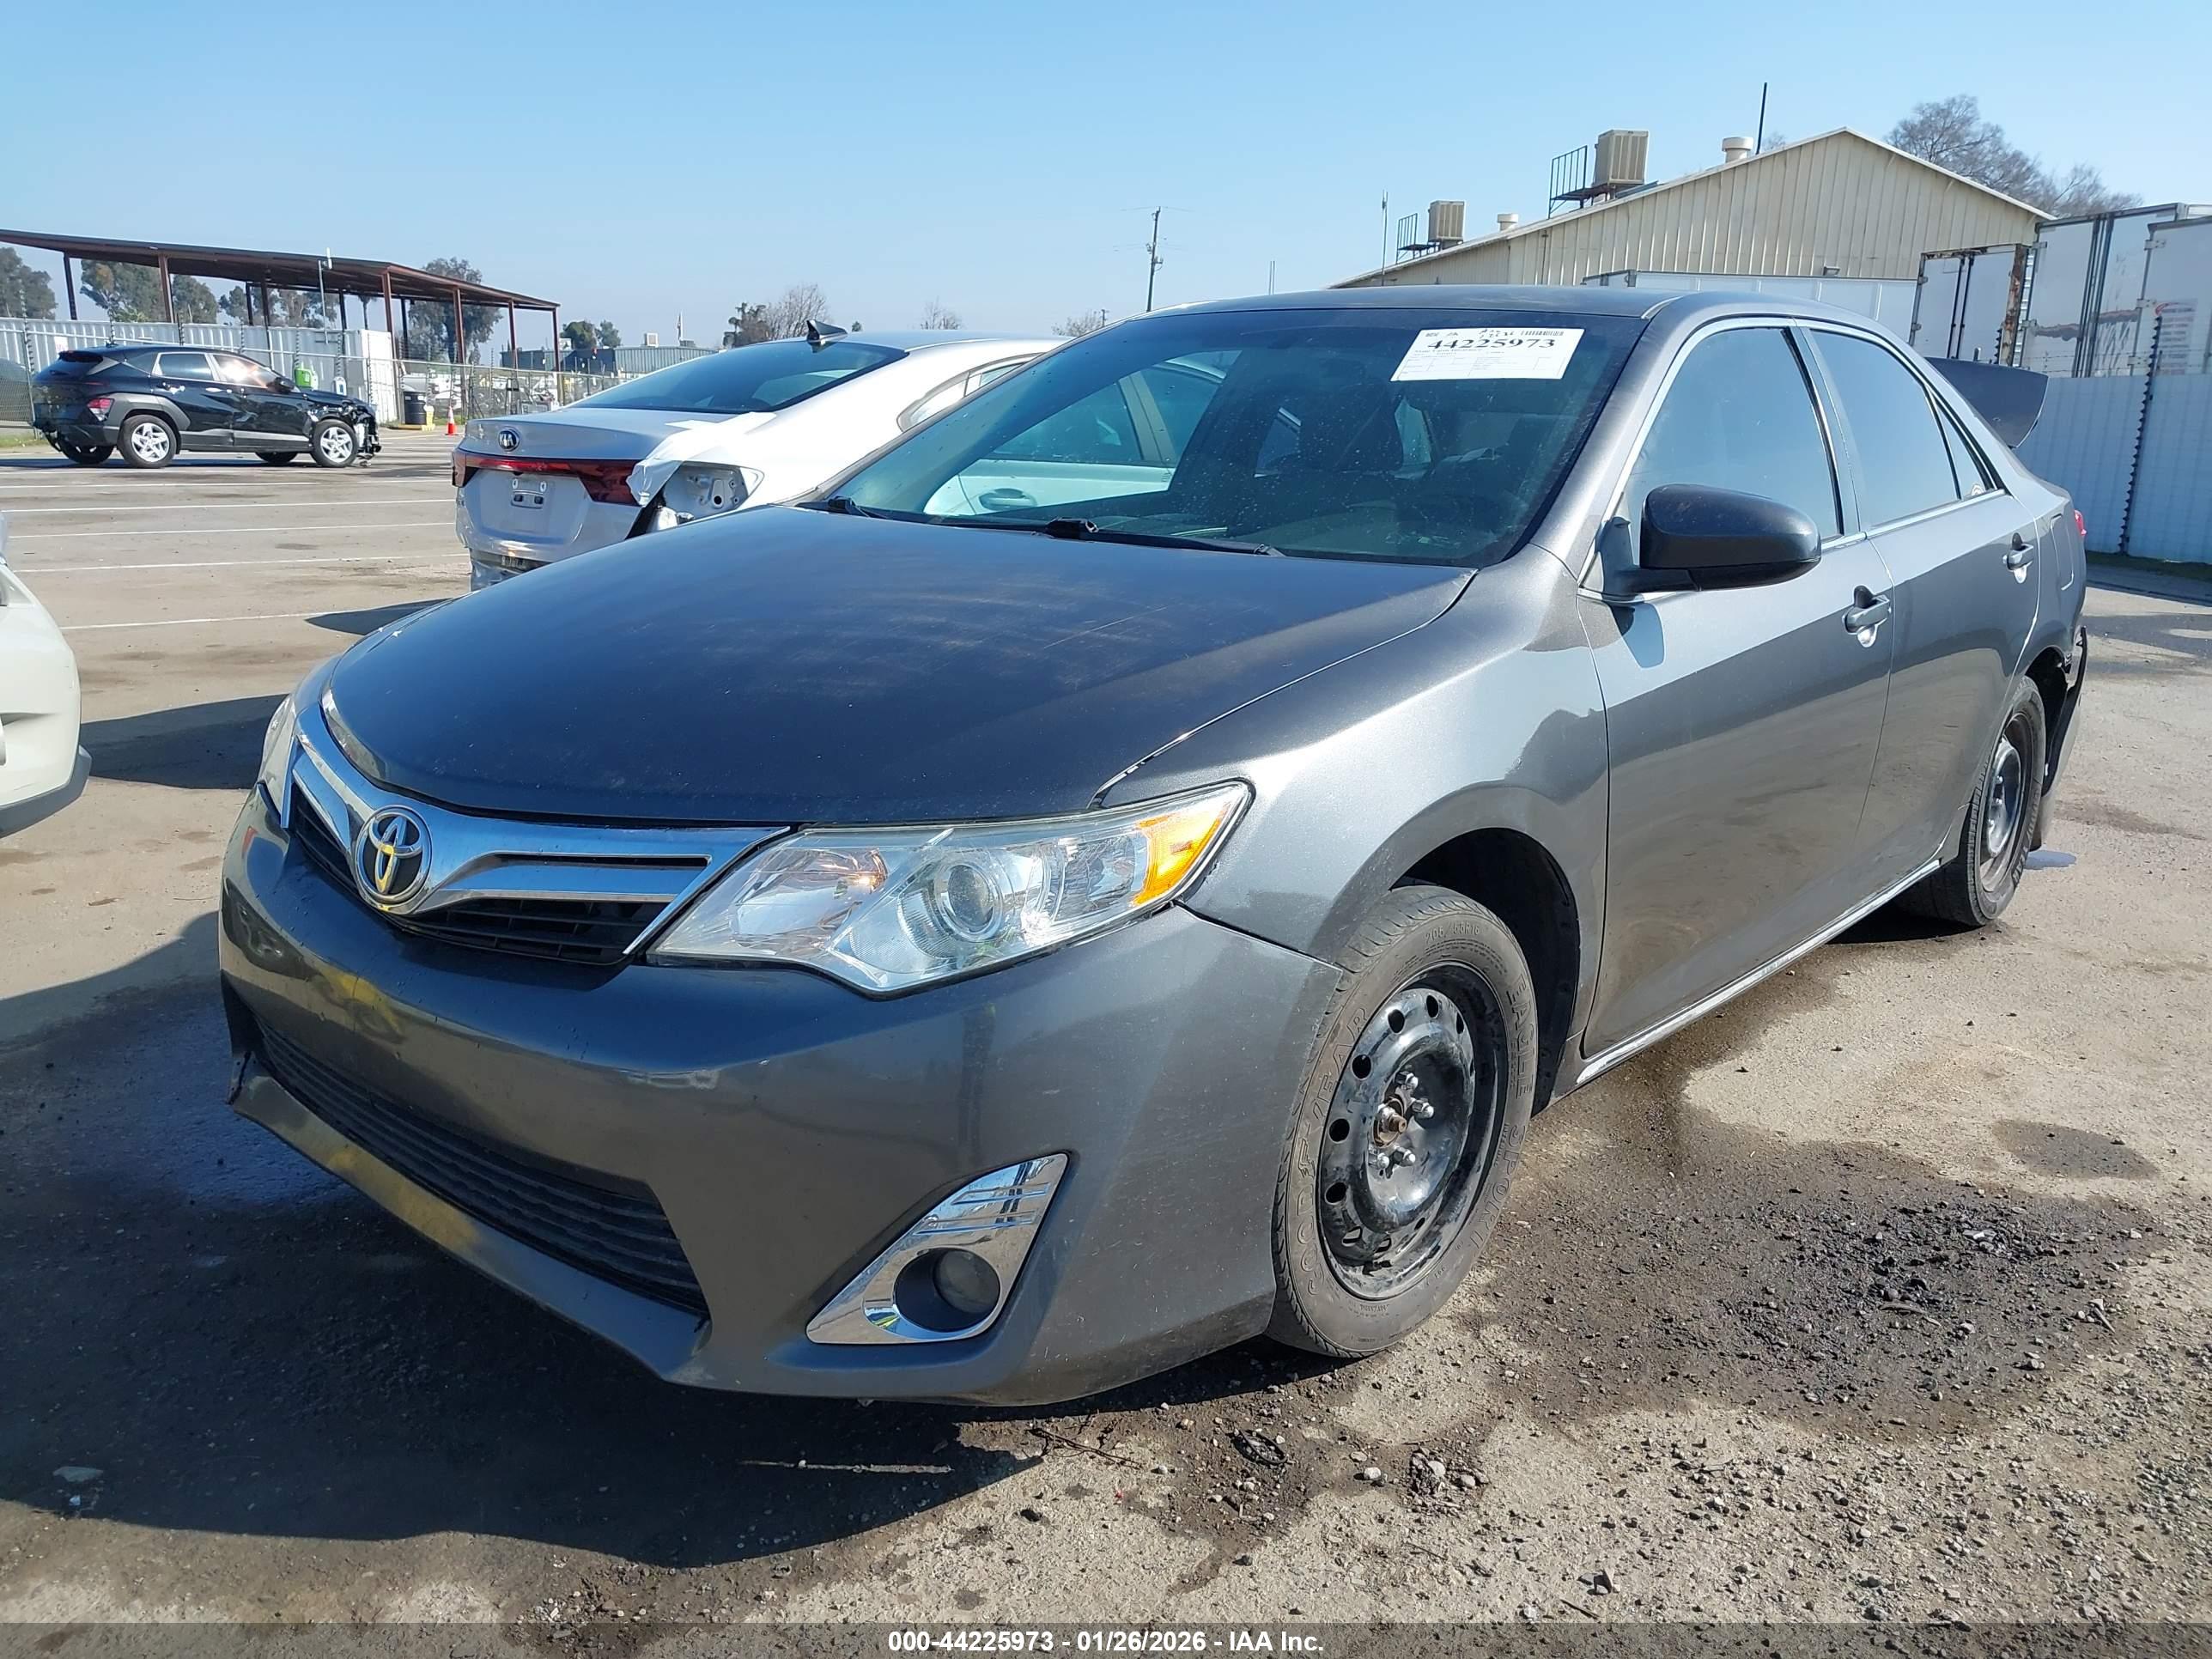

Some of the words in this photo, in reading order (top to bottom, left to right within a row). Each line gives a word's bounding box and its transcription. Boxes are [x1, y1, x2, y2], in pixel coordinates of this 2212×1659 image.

[1427, 337, 1557, 349] 44225973
[499, 433, 514, 447] KIA
[1506, 973, 1535, 1100] EAGLE
